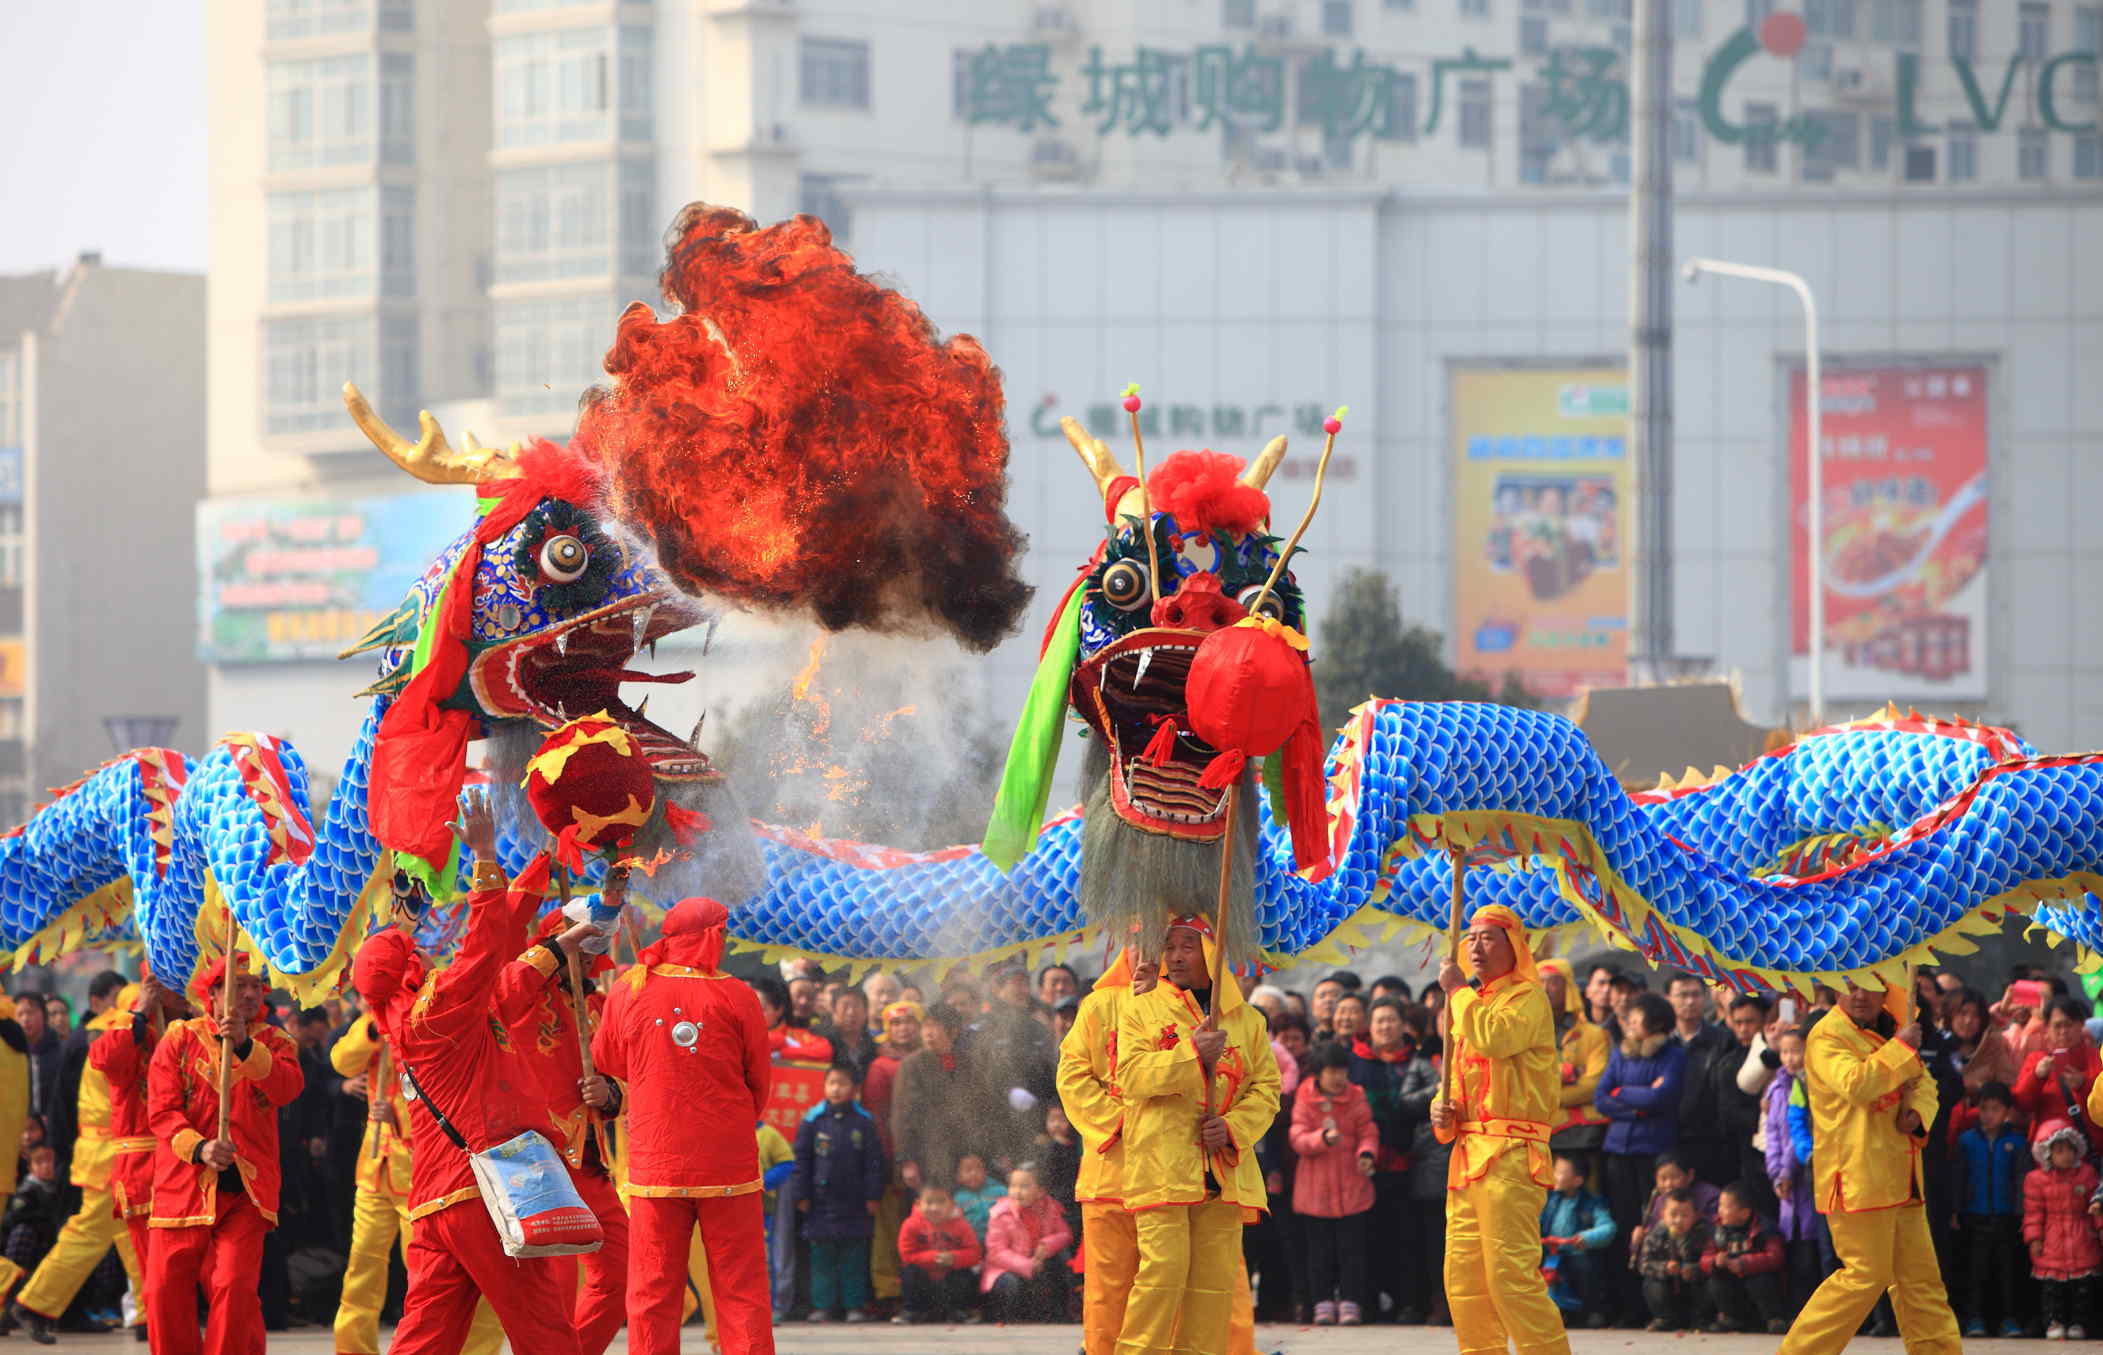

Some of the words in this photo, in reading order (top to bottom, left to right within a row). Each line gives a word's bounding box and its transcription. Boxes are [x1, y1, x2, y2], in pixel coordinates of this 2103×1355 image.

[967, 42, 1631, 140] 绿城购物广场
